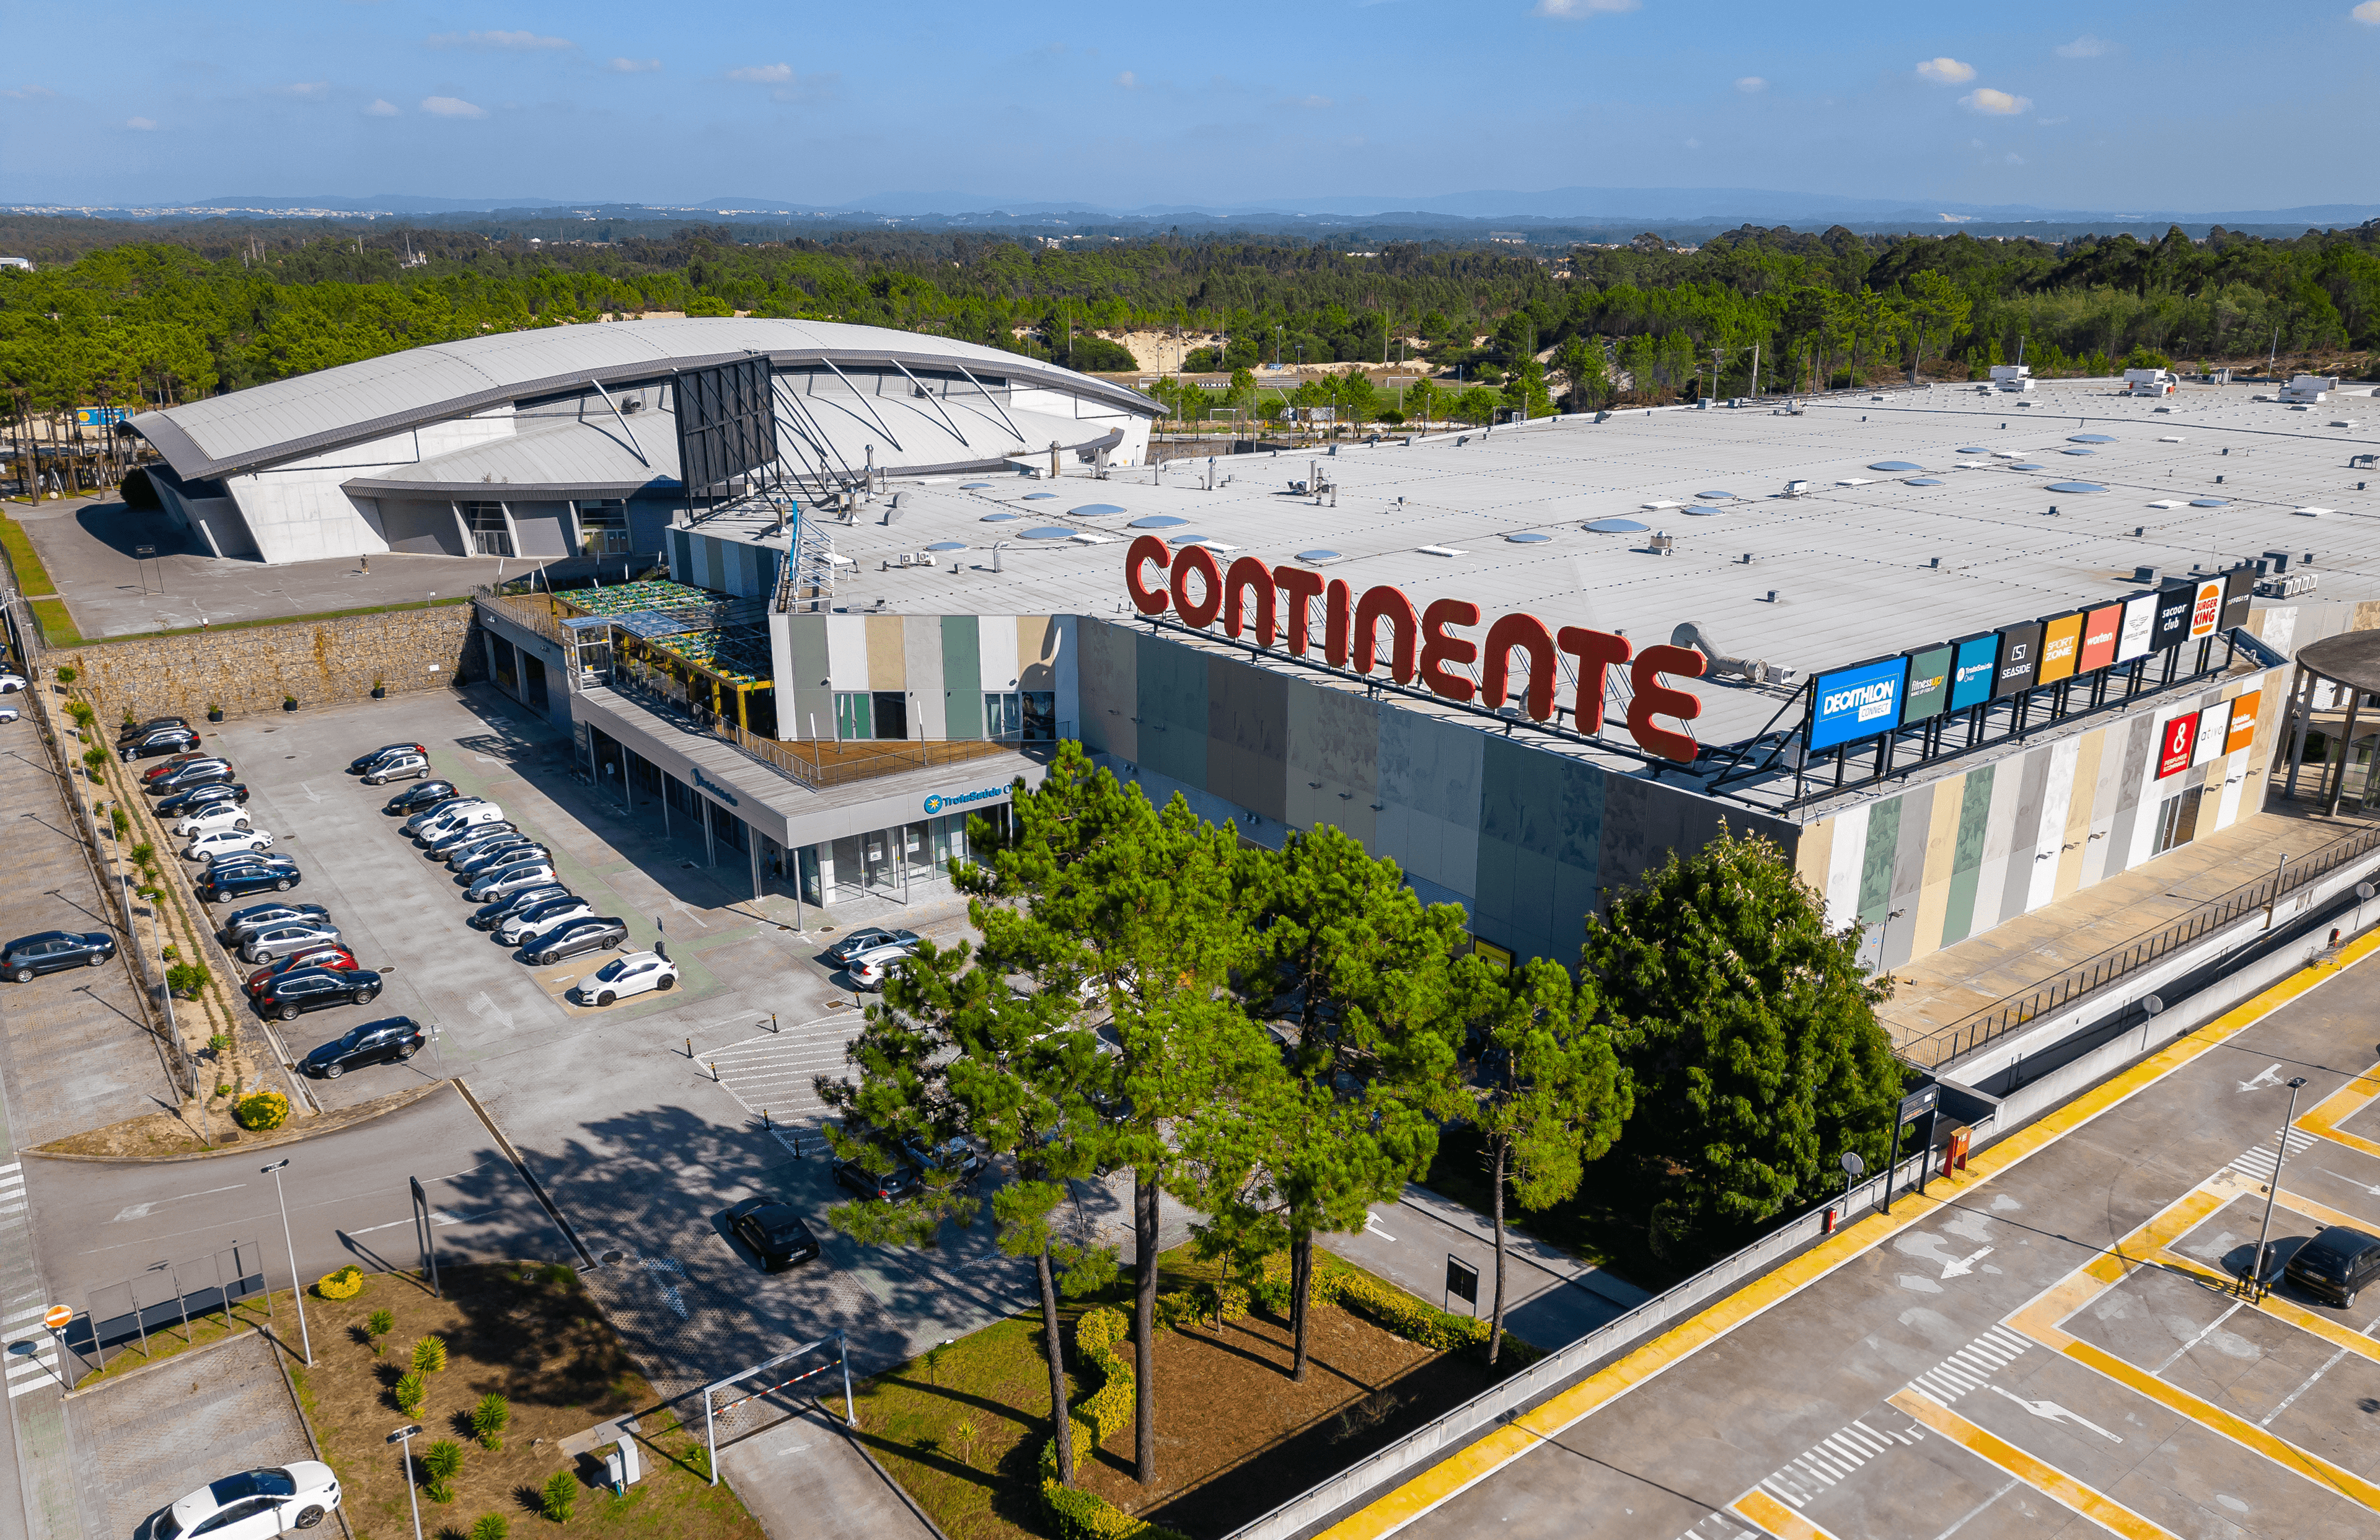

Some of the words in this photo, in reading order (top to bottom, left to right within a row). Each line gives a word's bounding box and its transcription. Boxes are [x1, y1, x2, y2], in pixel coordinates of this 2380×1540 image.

[2162, 604, 2187, 618] sacoor
[2197, 598, 2218, 612] BURGER
[2164, 617, 2179, 631] club
[2193, 609, 2216, 627] KING
[2047, 636, 2074, 651] SPORT
[2087, 631, 2113, 646] worten
[1125, 534, 1708, 763] CONTINENTE
[2045, 646, 2073, 662] ZONE
[2001, 662, 2032, 679] SEASIDE
[1823, 679, 1895, 715] DECATHLON
[1861, 703, 1889, 718] CONNECT
[2201, 725, 2223, 741] ativo
[943, 786, 1002, 807] TrofaSaúde
